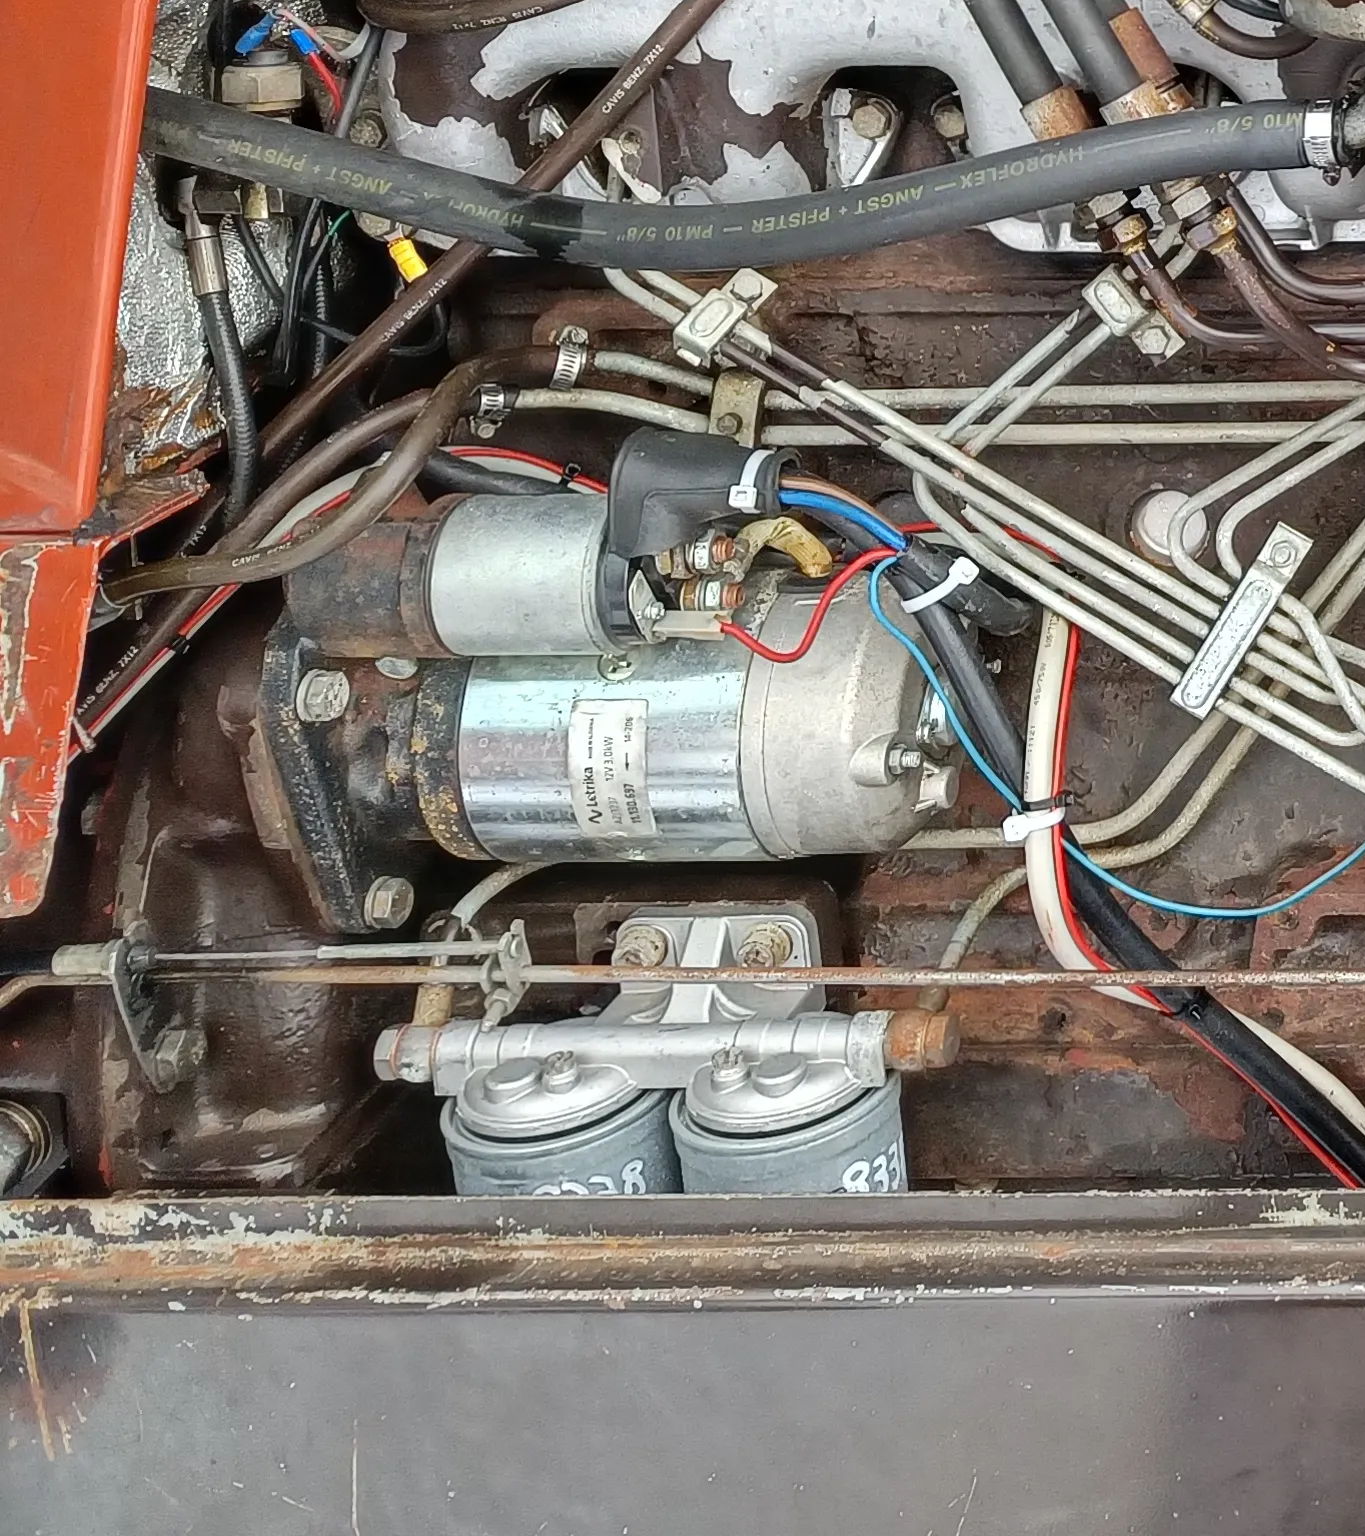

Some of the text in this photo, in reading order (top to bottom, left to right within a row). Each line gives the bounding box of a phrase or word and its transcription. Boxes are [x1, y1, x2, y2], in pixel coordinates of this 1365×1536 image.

[602, 89, 625, 114] CAVIS
[227, 139, 307, 173] PFISTER
[959, 145, 1084, 190] HYDROFLEX
[330, 166, 393, 197] ANGST
[855, 183, 925, 216] ANGST
[665, 223, 714, 242] PM10
[750, 205, 831, 234] PFISTER
[582, 766, 599, 807] Letrika
